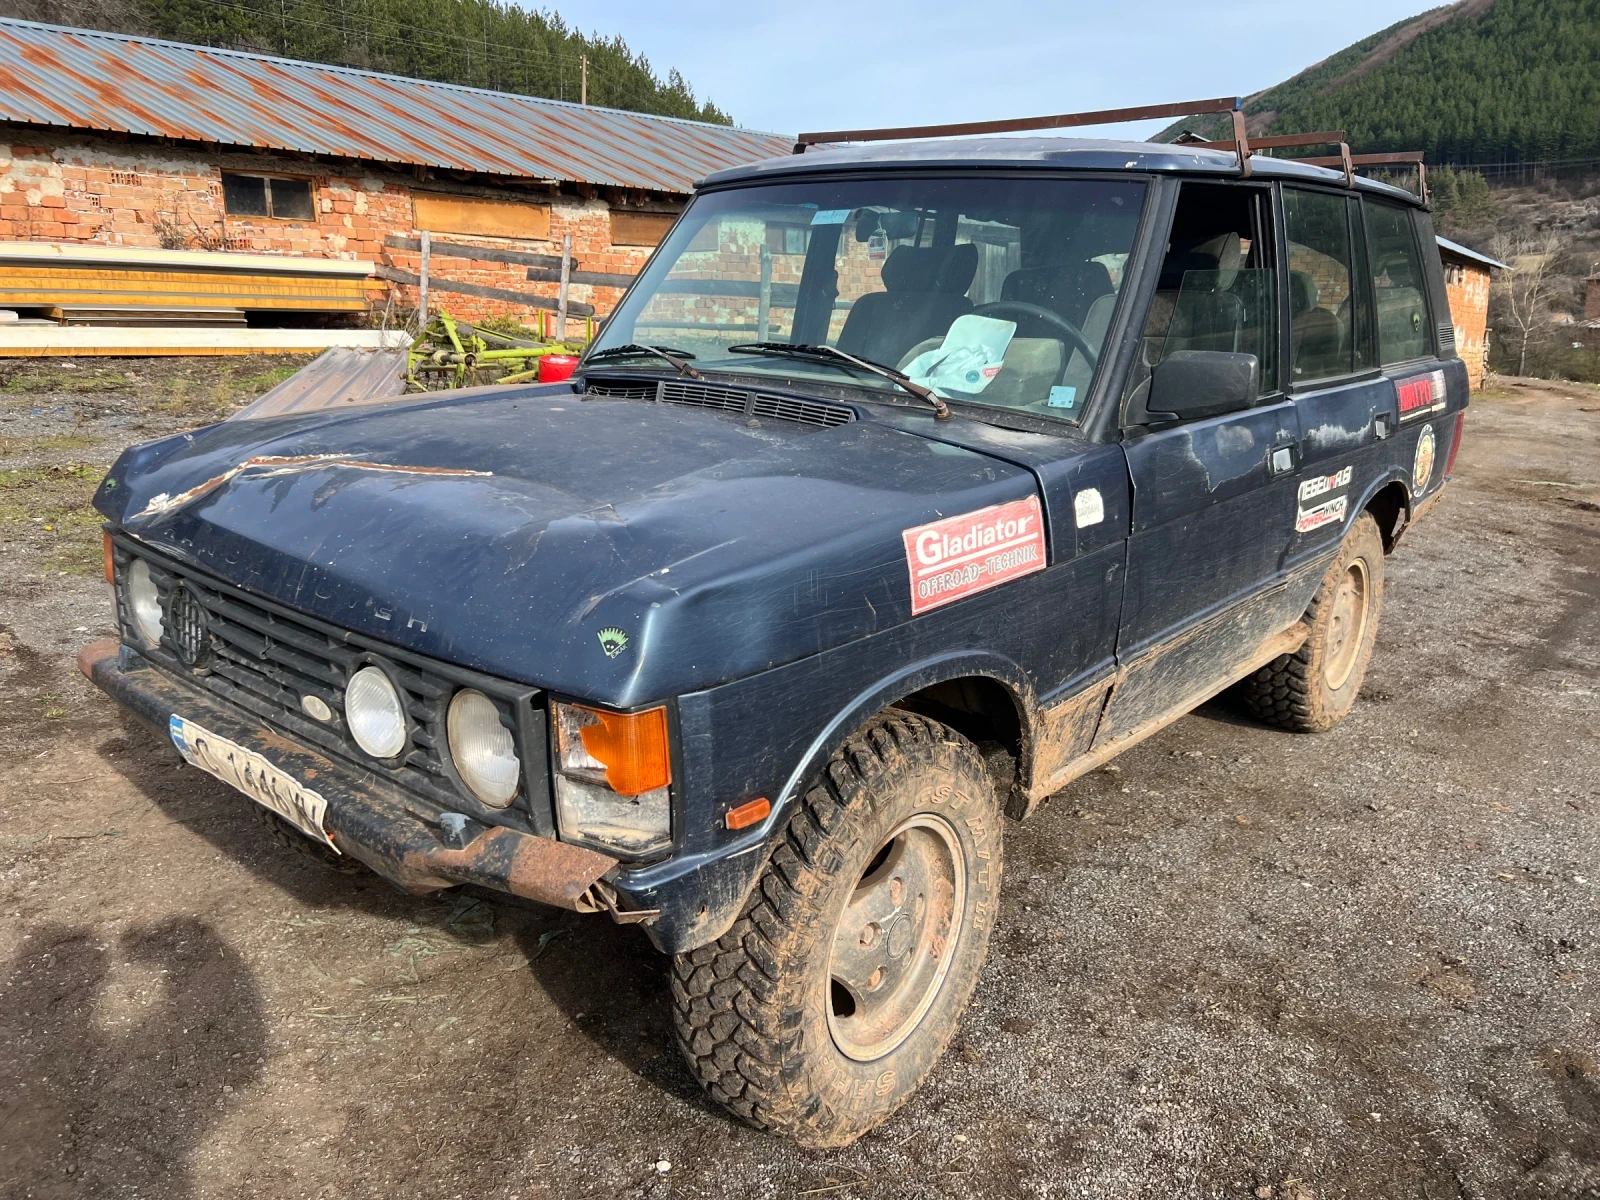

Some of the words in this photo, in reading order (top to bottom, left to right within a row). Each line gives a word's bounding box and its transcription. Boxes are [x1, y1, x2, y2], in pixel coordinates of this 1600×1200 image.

[1298, 510, 1325, 531] POWER
[1323, 499, 1345, 517] WINCH
[916, 514, 1034, 566] Gladiator
[918, 544, 1038, 599] OFFROAD-TECHNIK
[912, 783, 972, 811] CST
